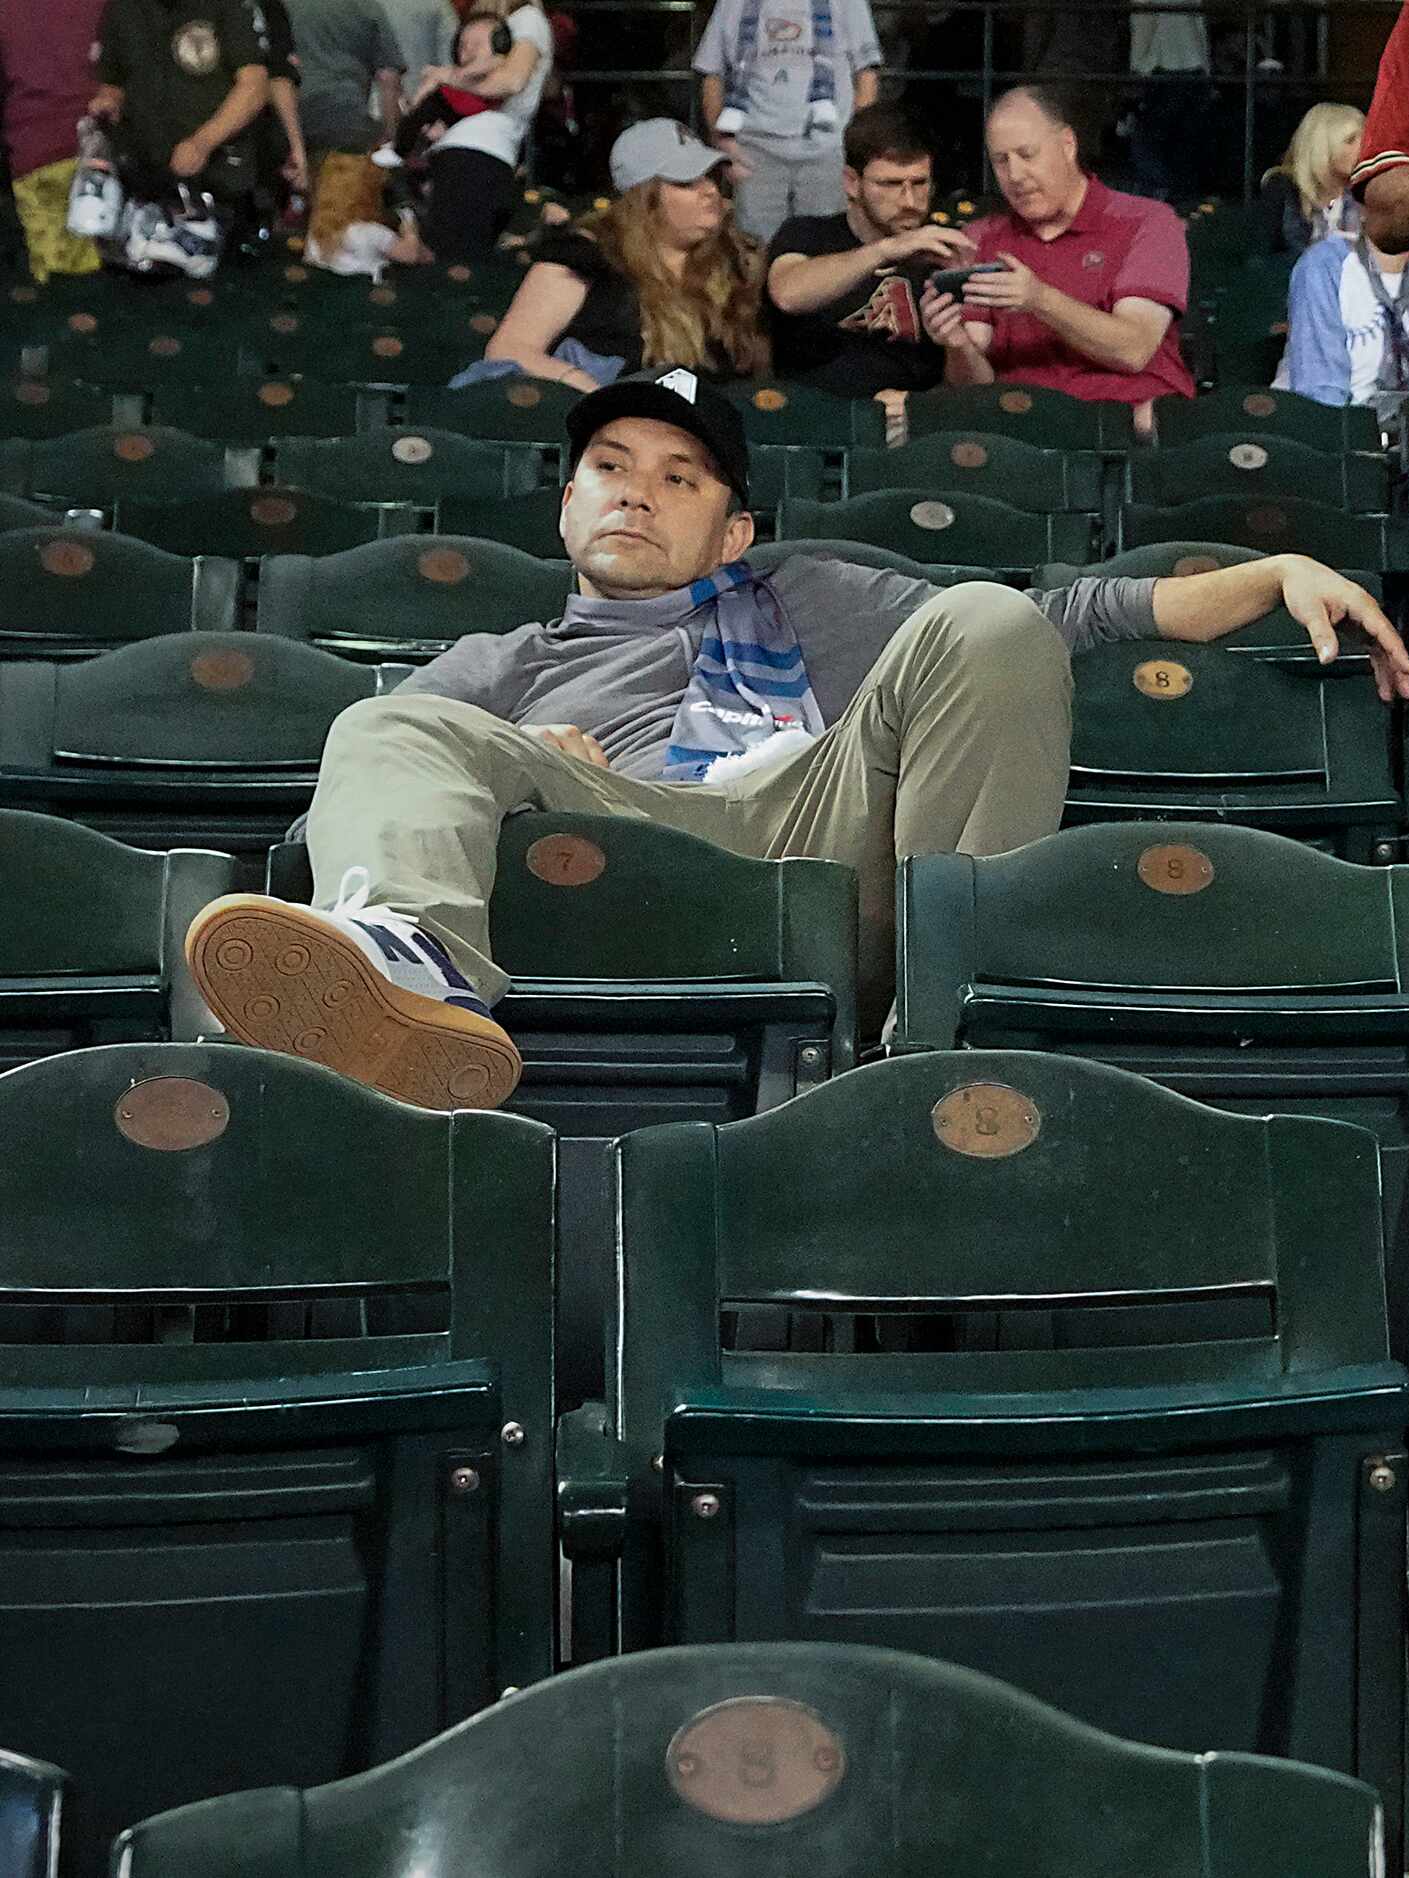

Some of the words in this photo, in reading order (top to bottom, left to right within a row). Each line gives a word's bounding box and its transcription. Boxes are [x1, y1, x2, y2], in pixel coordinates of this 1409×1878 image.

[1155, 671, 1171, 689] 8
[558, 852, 575, 872] 7
[975, 1106, 1001, 1136] 8
